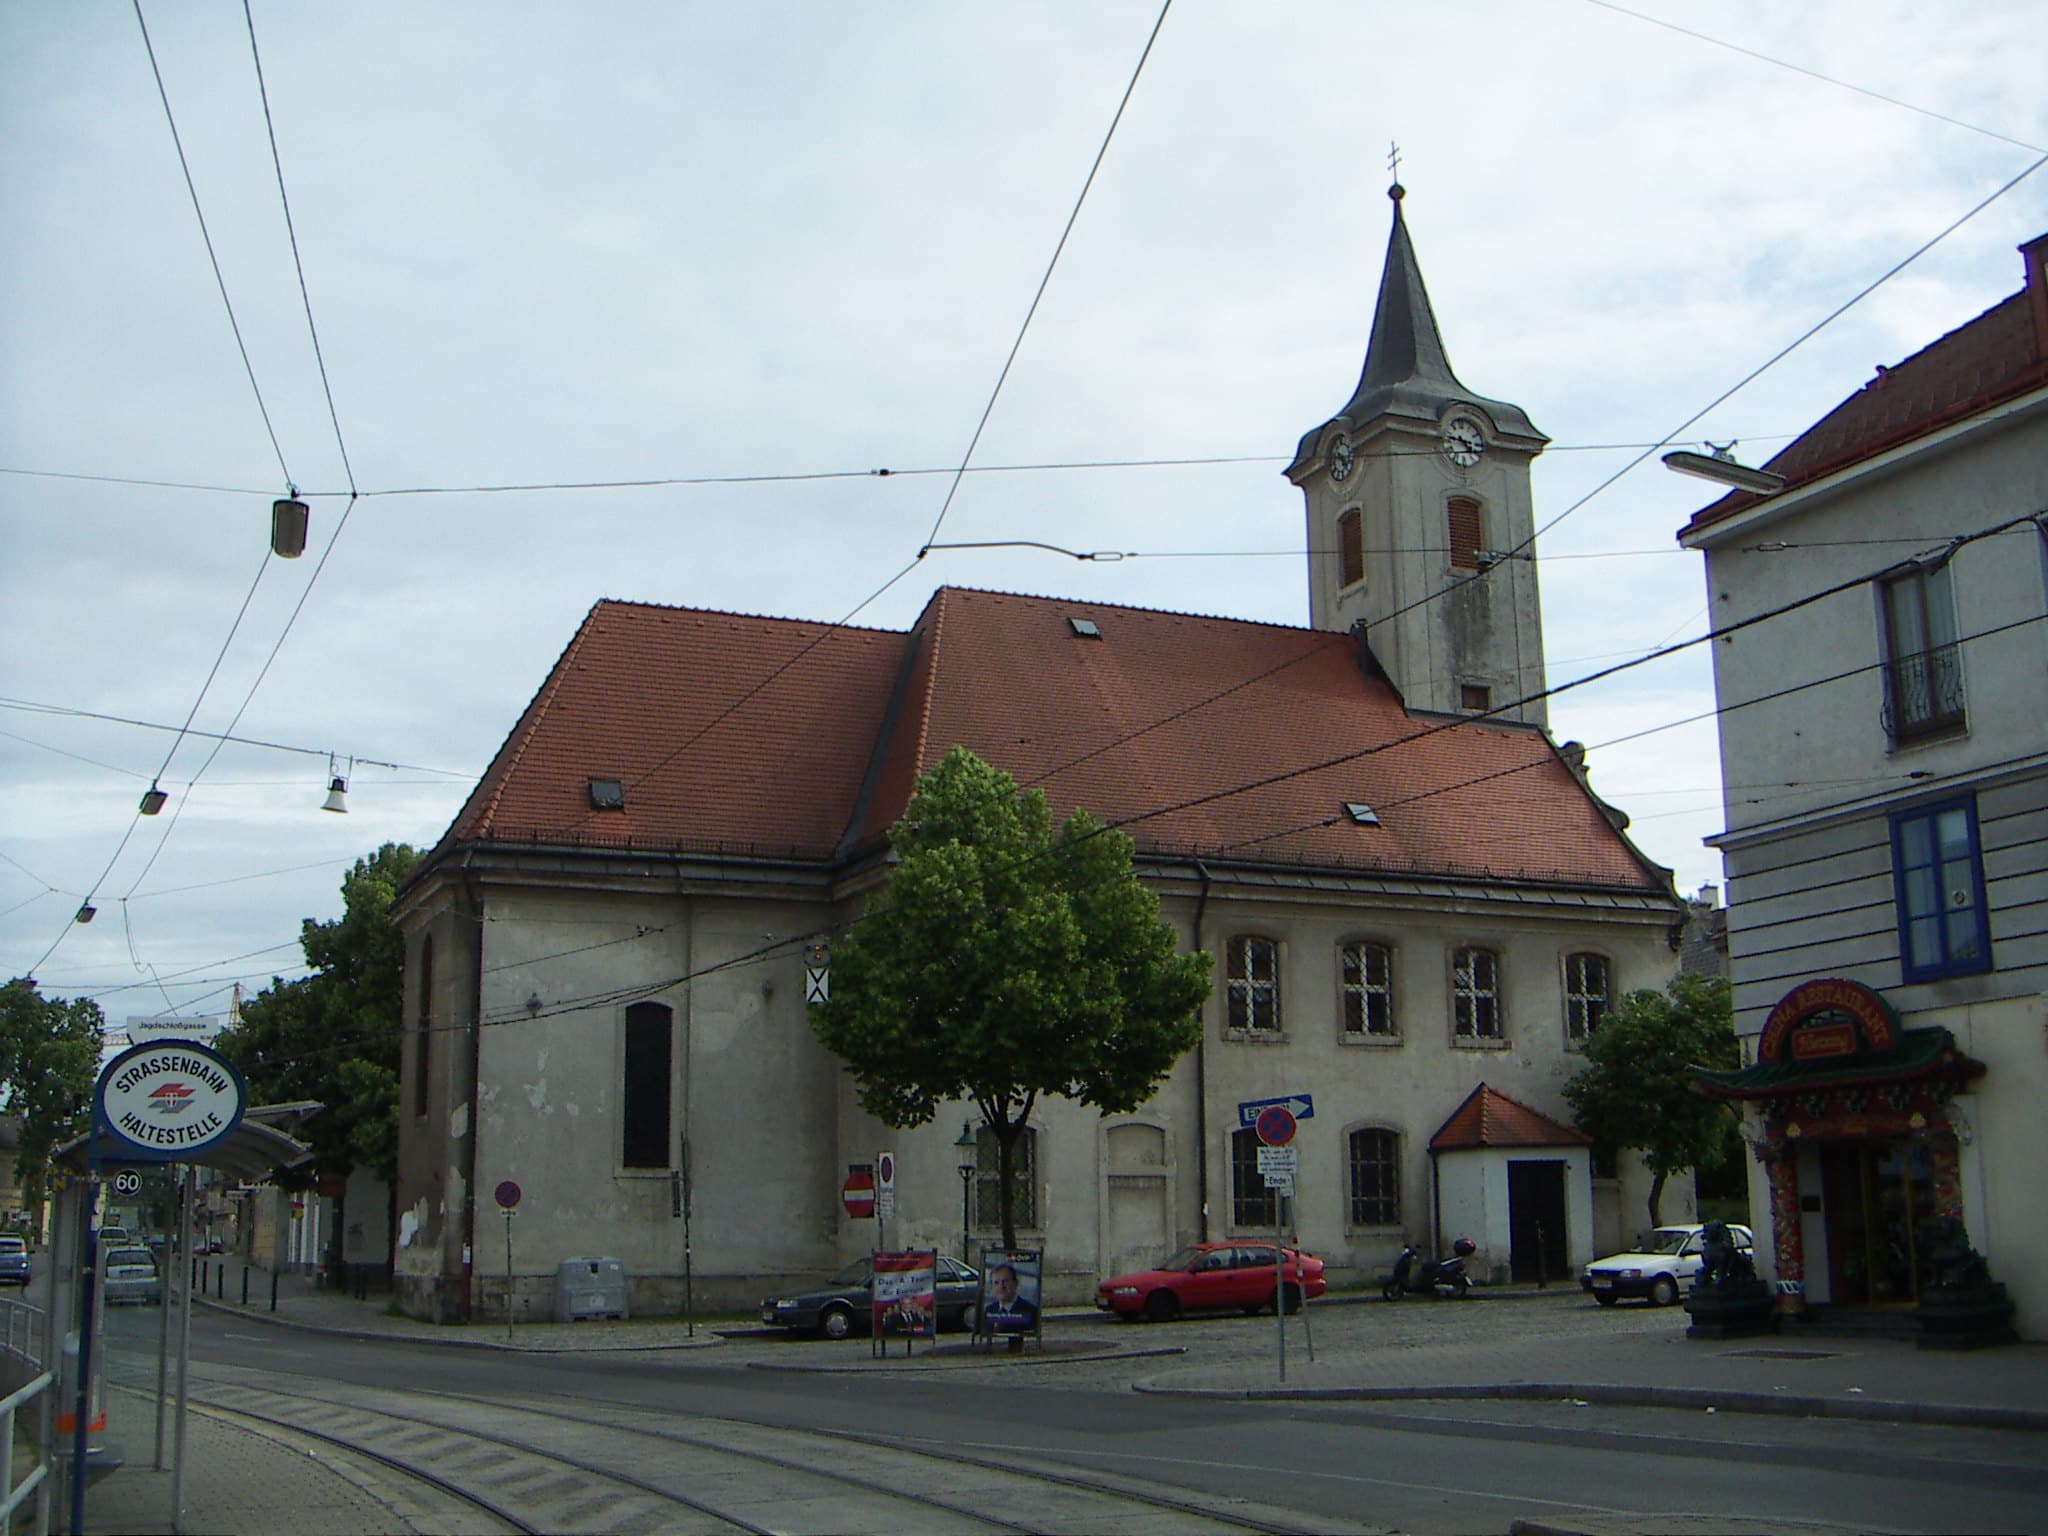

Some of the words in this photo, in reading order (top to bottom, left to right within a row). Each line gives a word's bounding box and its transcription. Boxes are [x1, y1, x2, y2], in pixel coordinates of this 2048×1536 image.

[115, 1056, 228, 1094] STRASSENBAHN
[120, 1112, 223, 1144] HALTESTELLE
[115, 1174, 139, 1190] 60
